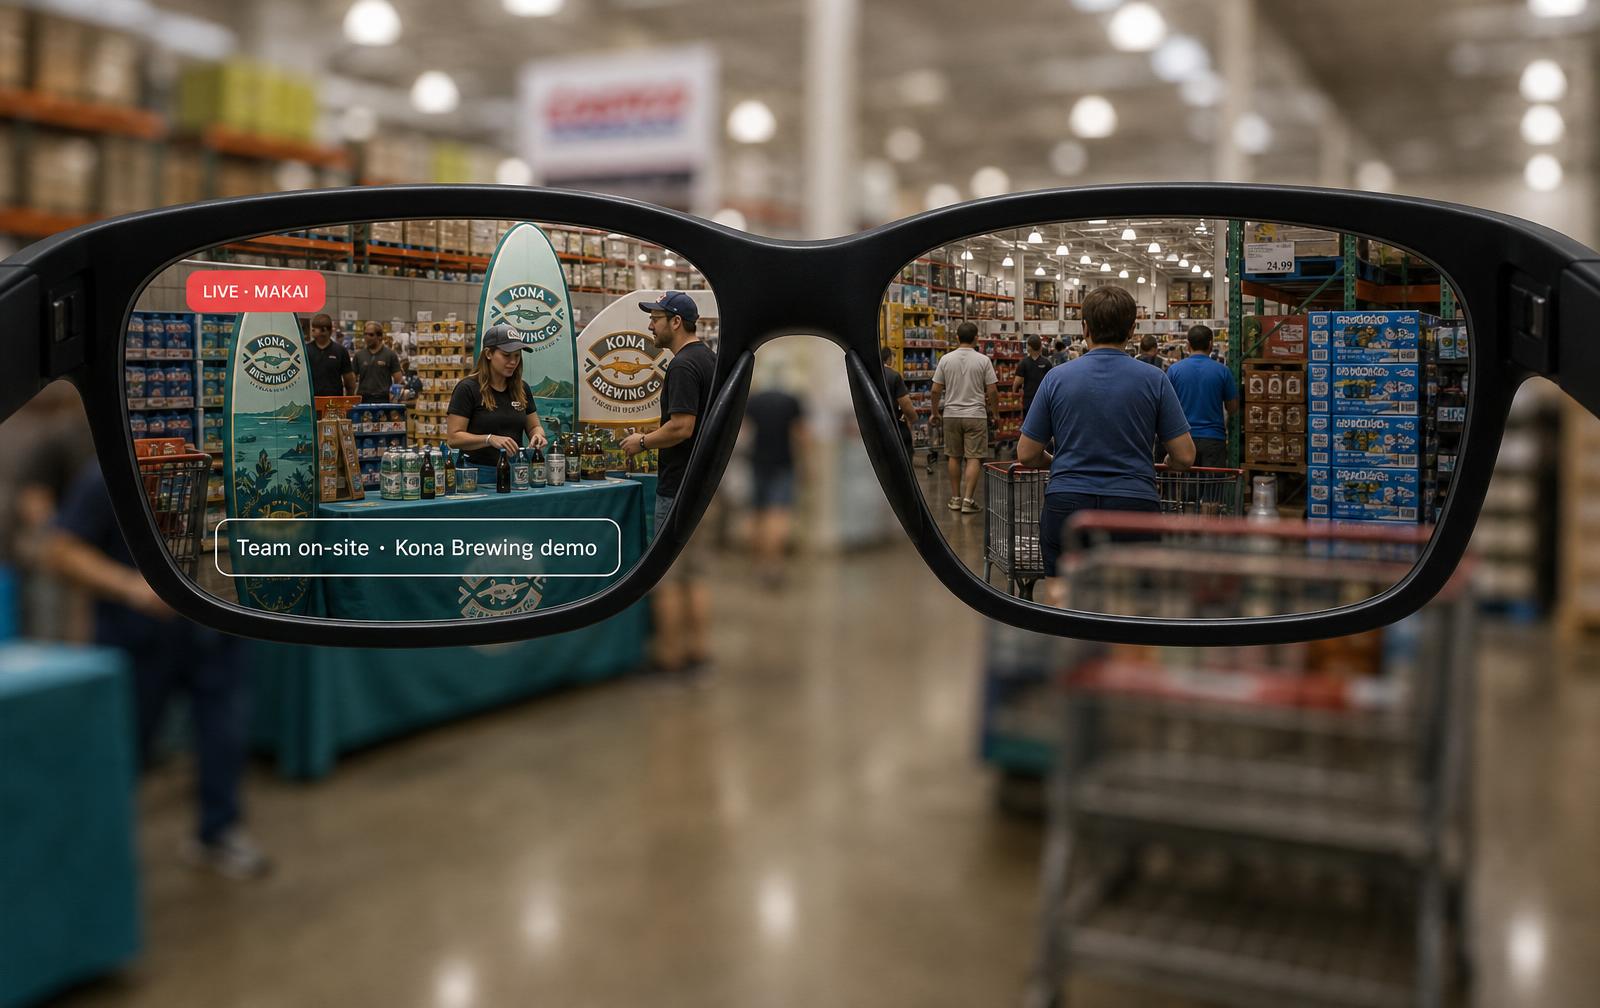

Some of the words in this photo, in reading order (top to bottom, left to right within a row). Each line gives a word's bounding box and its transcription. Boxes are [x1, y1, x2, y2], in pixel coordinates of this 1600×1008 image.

[1266, 260, 1293, 271] 24.99
[509, 286, 545, 301] KONA
[257, 336, 286, 349] KONA
[605, 334, 646, 351] KONA
[592, 376, 646, 401] BREWING
